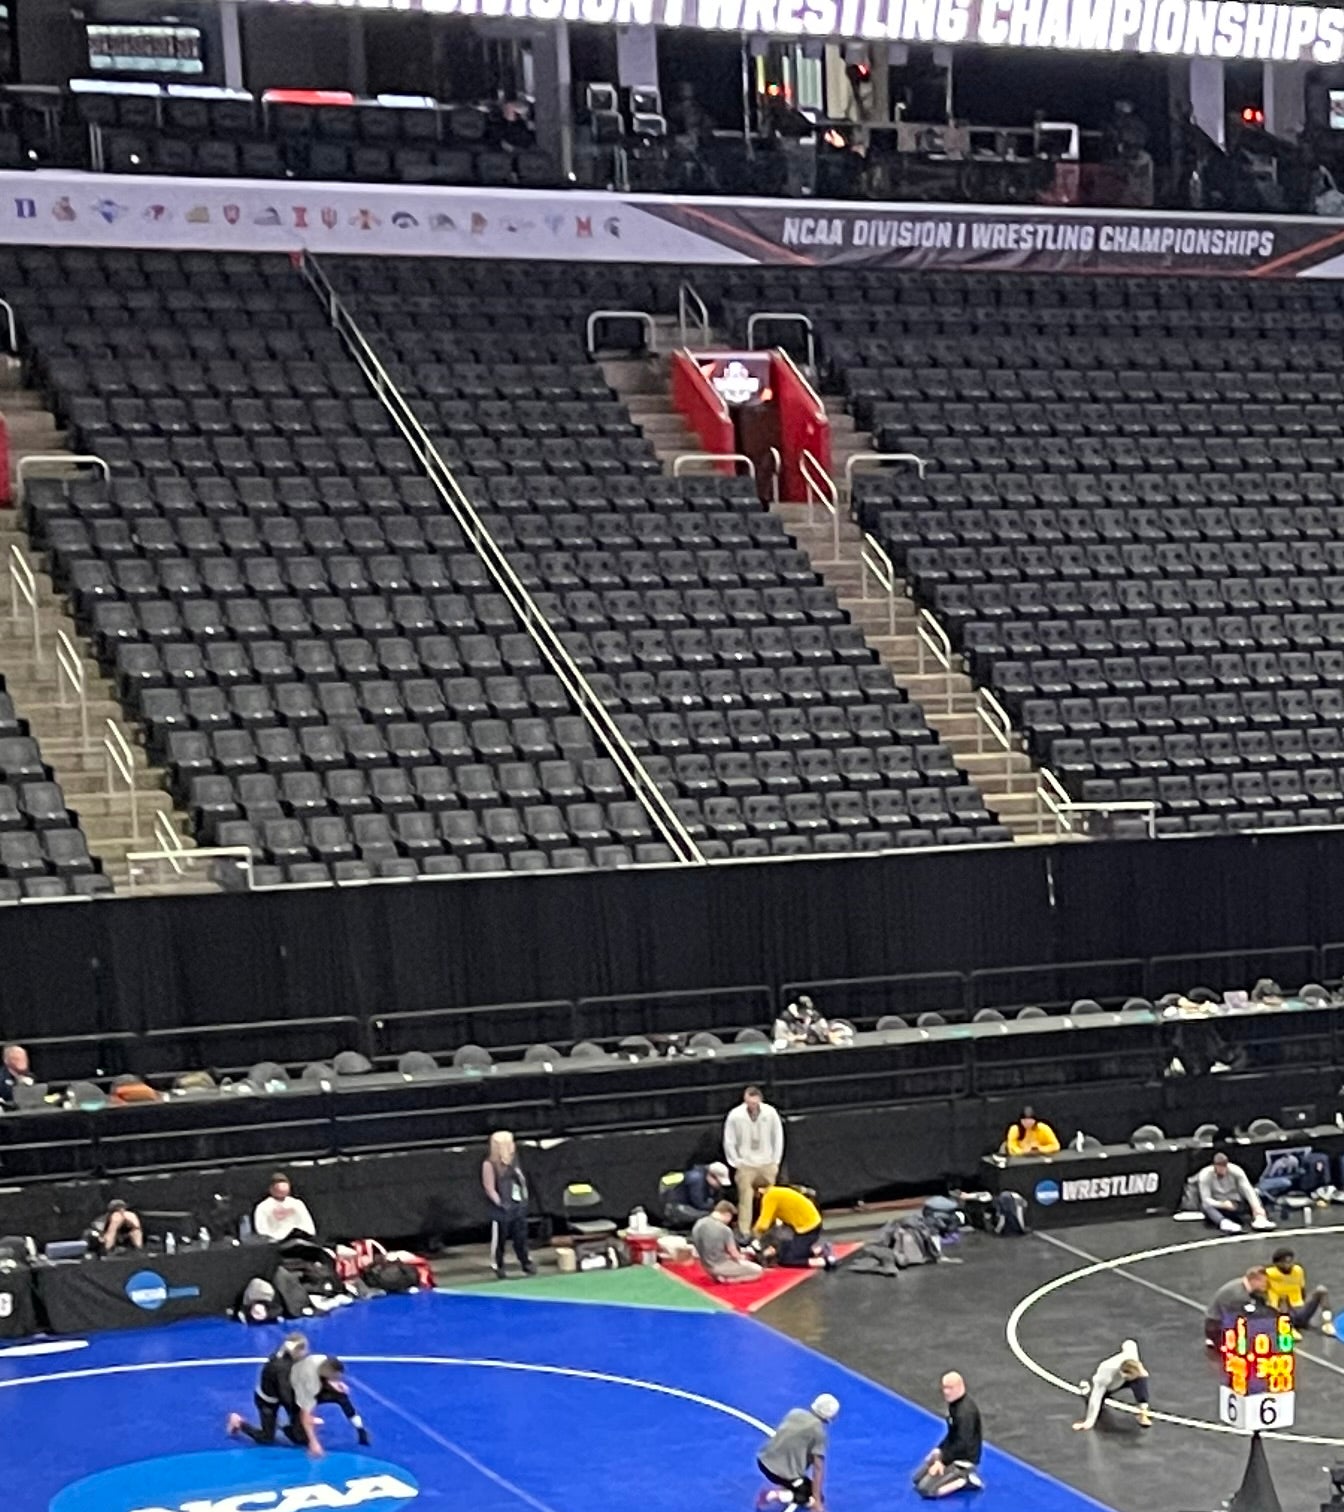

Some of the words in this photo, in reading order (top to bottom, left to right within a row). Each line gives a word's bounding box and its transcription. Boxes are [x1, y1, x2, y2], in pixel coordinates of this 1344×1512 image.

[782, 217, 844, 246] NCAA
[852, 219, 953, 248] DIVISION
[956, 222, 966, 248] I
[971, 223, 1095, 251] WRESTLING
[1100, 226, 1275, 257] CHAMPIONSHIPS
[1062, 1172, 1159, 1201] WRESTLING
[1227, 1393, 1237, 1422] 6
[1260, 1397, 1277, 1425] 6
